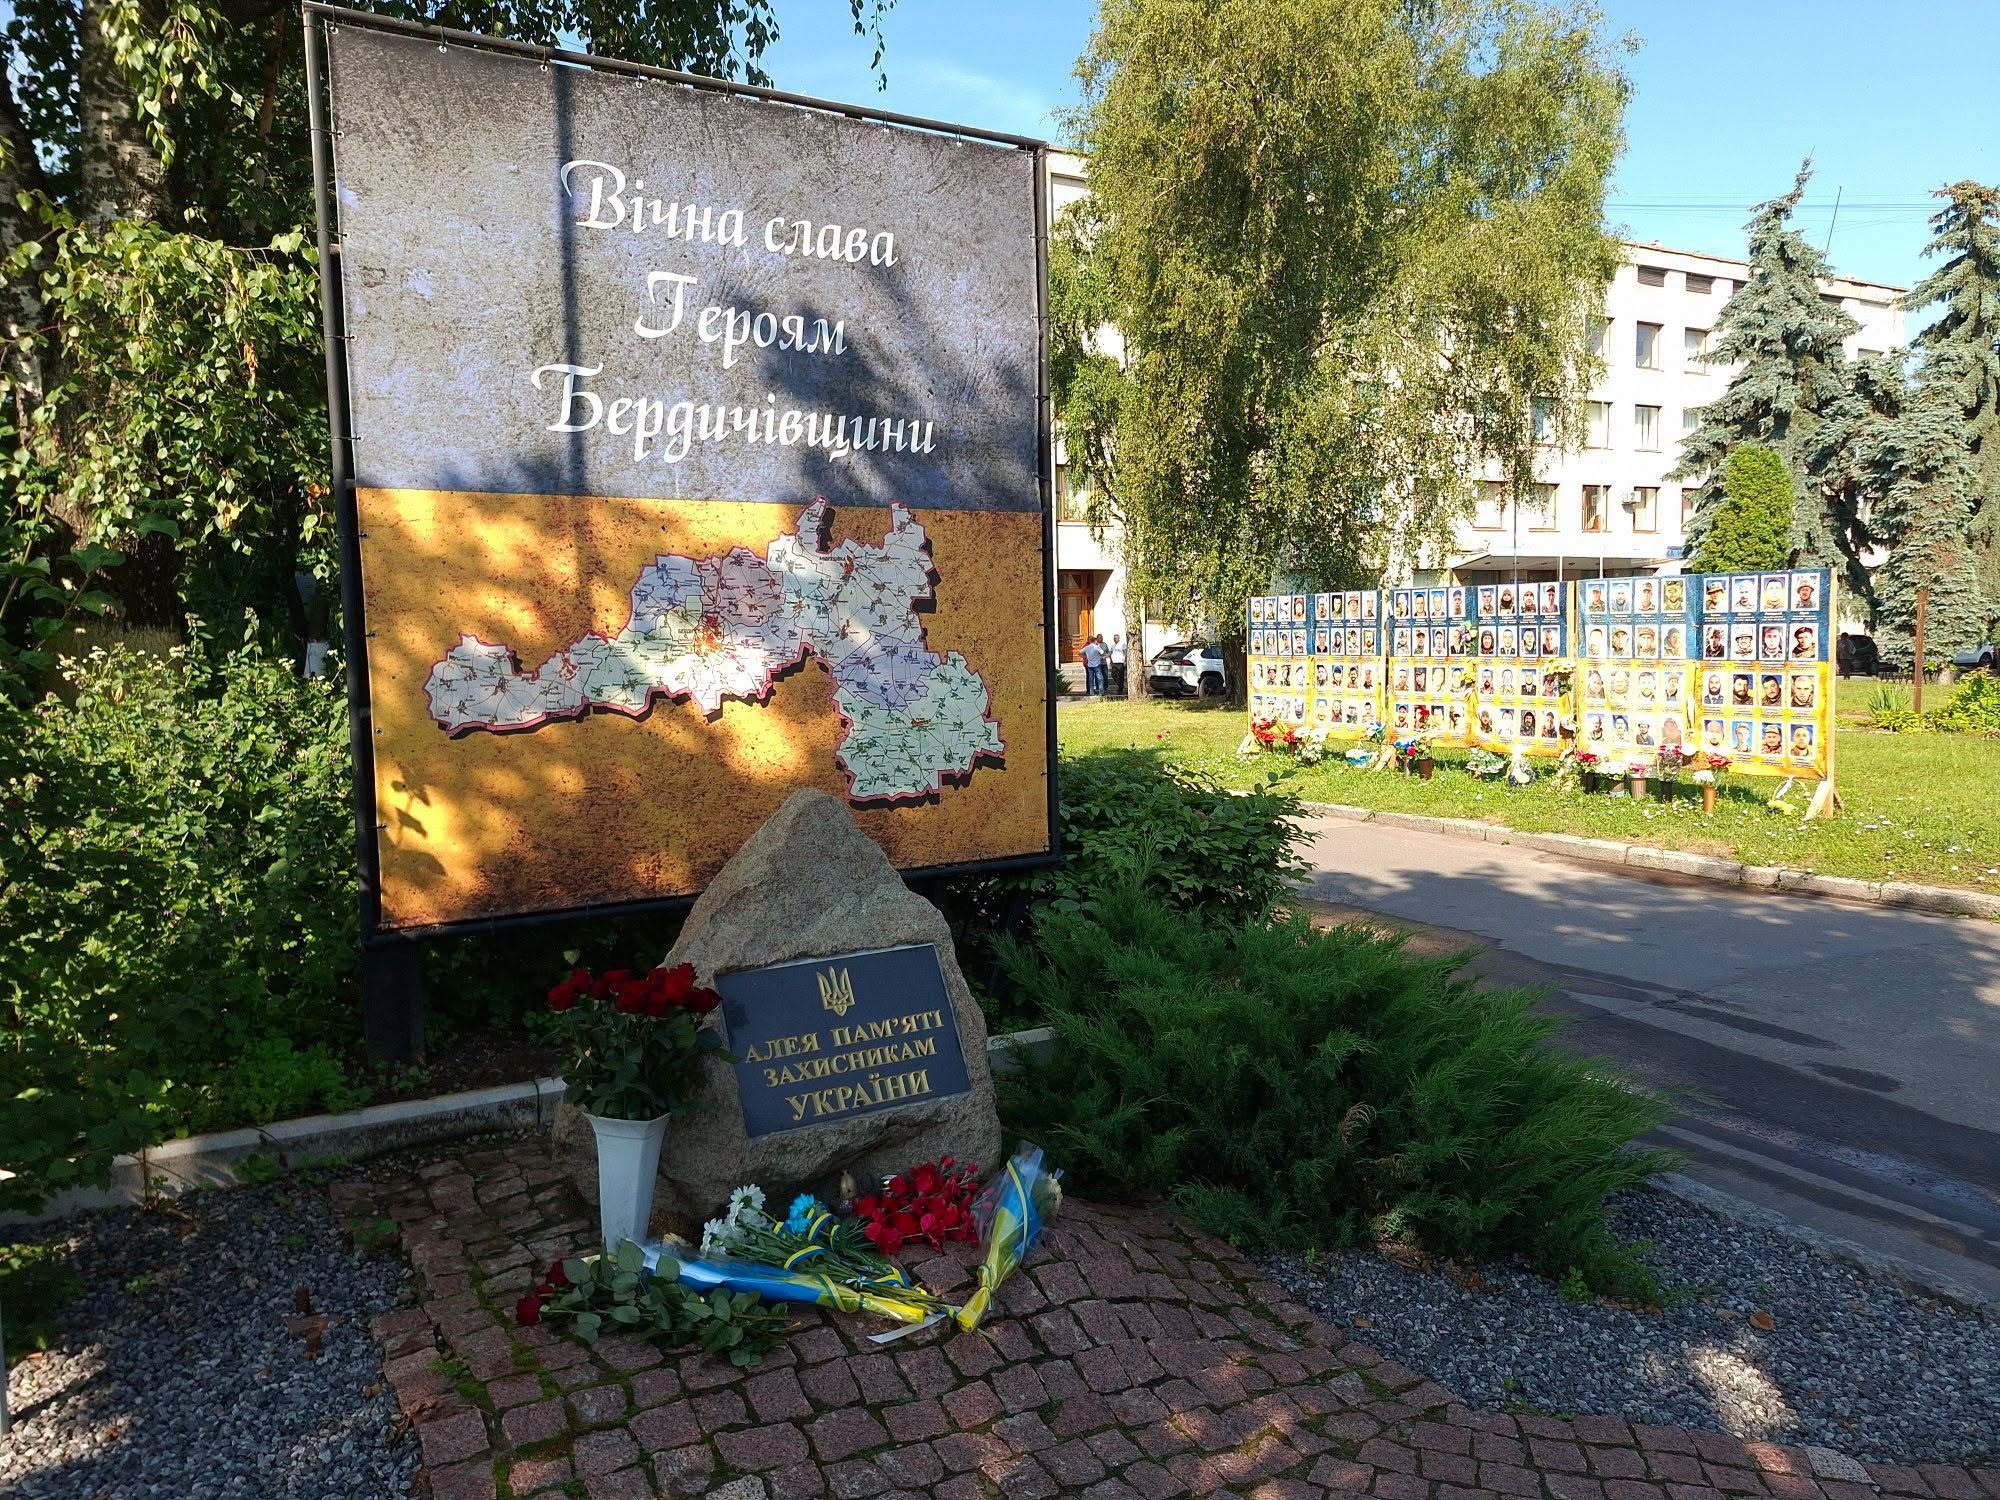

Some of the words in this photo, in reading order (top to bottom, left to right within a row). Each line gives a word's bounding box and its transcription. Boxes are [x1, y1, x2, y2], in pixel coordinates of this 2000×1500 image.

[560, 159, 748, 248] Вічна
[764, 216, 899, 268] слава
[634, 270, 847, 369] Героям
[530, 362, 937, 464] Бердичівщини
[744, 1032, 820, 1064] АЛЕЯ
[763, 1037, 938, 1088] ЗАХИСНИКАМ
[784, 1069, 933, 1121] УКРАЇНИ
